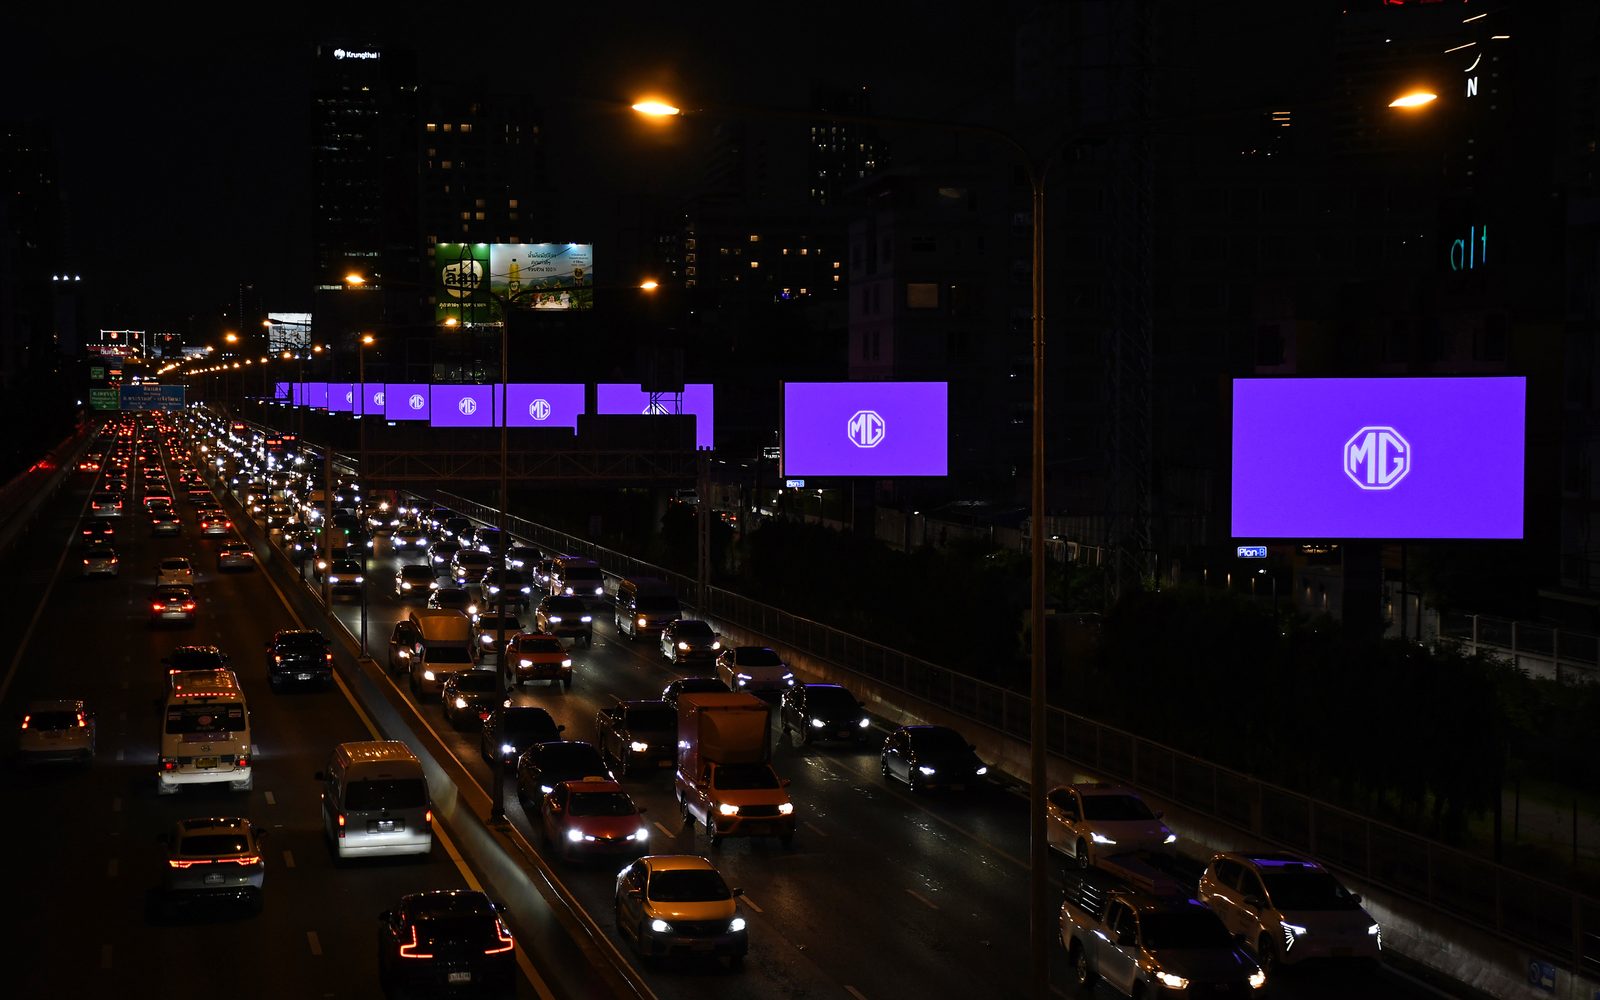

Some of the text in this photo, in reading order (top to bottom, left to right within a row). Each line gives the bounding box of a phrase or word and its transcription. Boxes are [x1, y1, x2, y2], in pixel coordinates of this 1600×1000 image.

[1451, 225, 1487, 270] alt
[409, 395, 424, 410] MG
[459, 397, 476, 415] MG
[530, 400, 550, 420] MG
[849, 412, 884, 447] MG
[1346, 428, 1408, 488] MG
